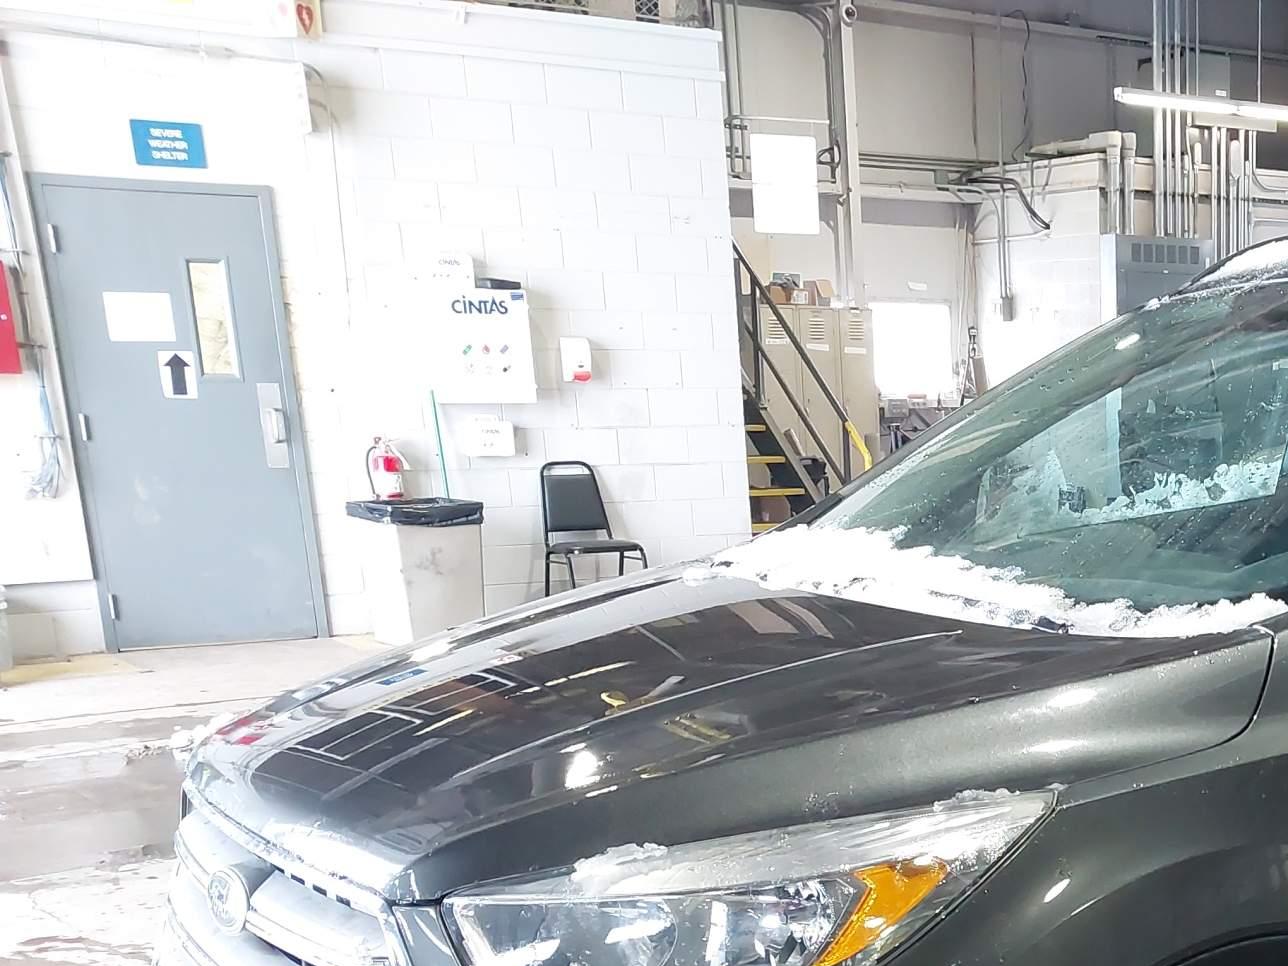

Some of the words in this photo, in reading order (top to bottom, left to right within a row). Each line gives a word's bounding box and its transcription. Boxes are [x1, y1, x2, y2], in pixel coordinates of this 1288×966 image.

[148, 127, 184, 138] SEVERE
[147, 139, 189, 150] WEATHER
[151, 150, 189, 161] SHELTER
